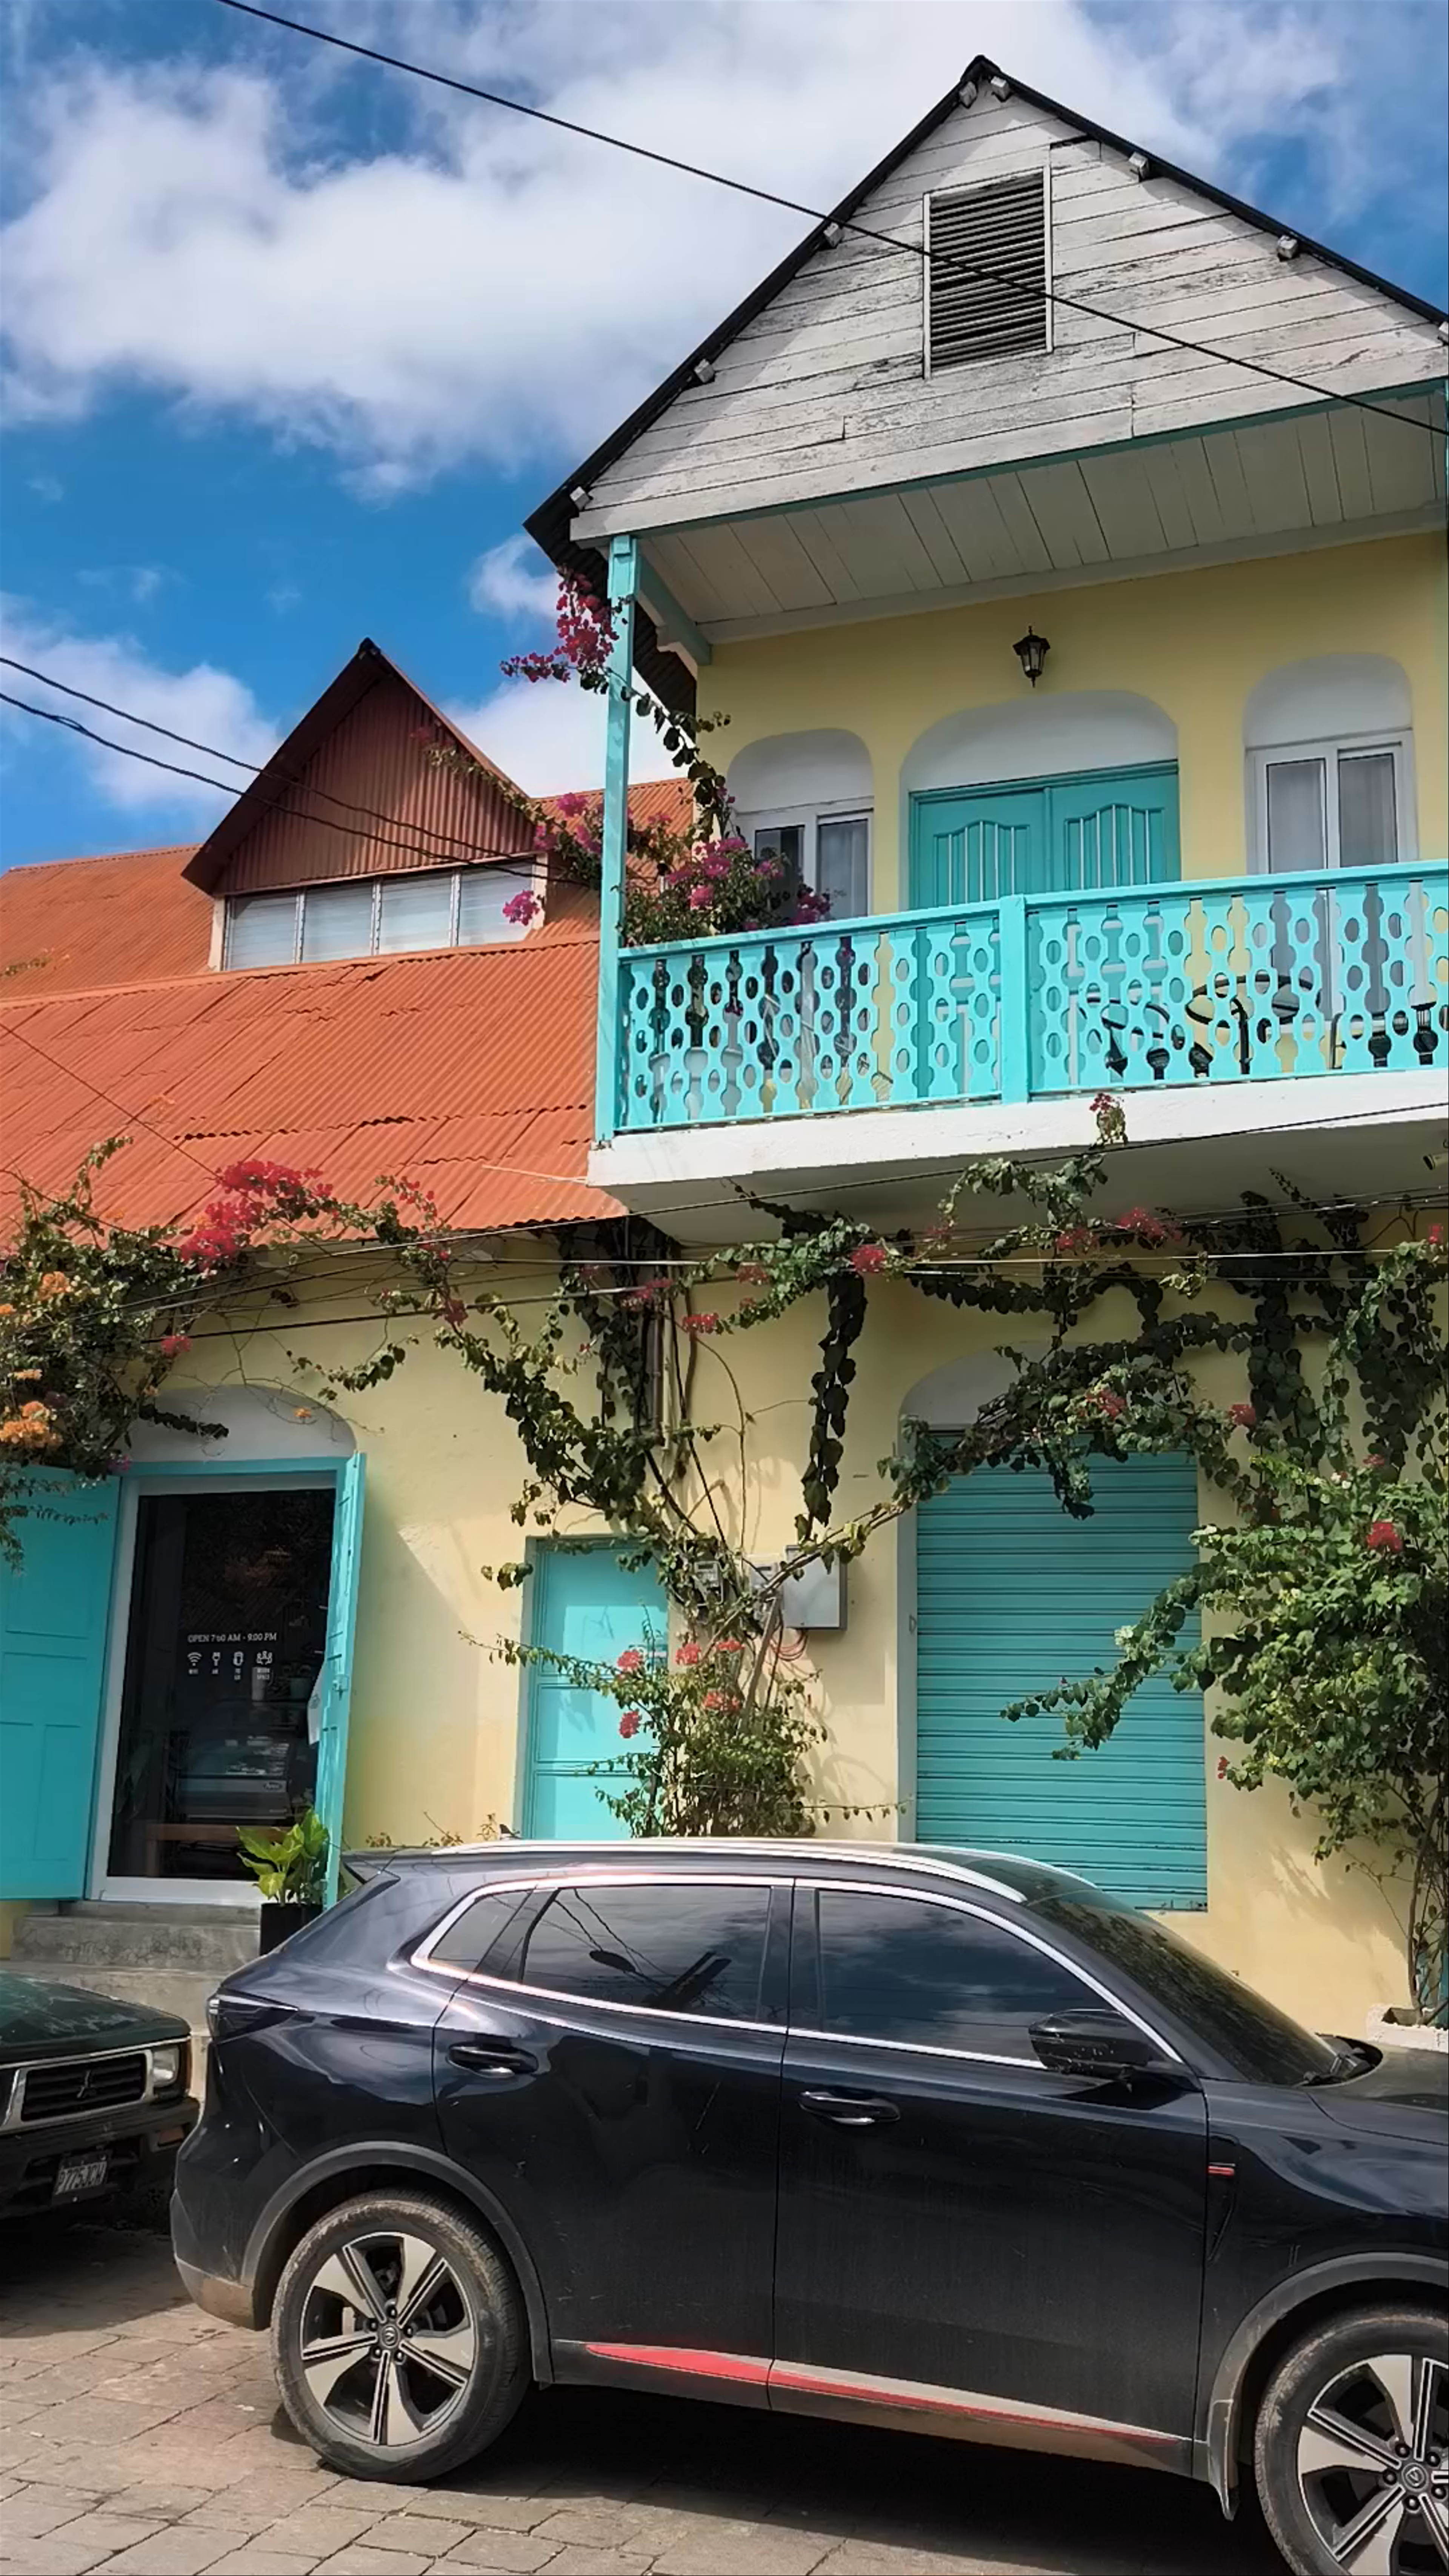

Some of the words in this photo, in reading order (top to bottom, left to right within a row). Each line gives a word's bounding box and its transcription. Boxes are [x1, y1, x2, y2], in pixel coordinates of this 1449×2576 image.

[188, 1634, 209, 1642] OPEN
[228, 1633, 241, 1641] AM
[264, 1632, 277, 1641] PM
